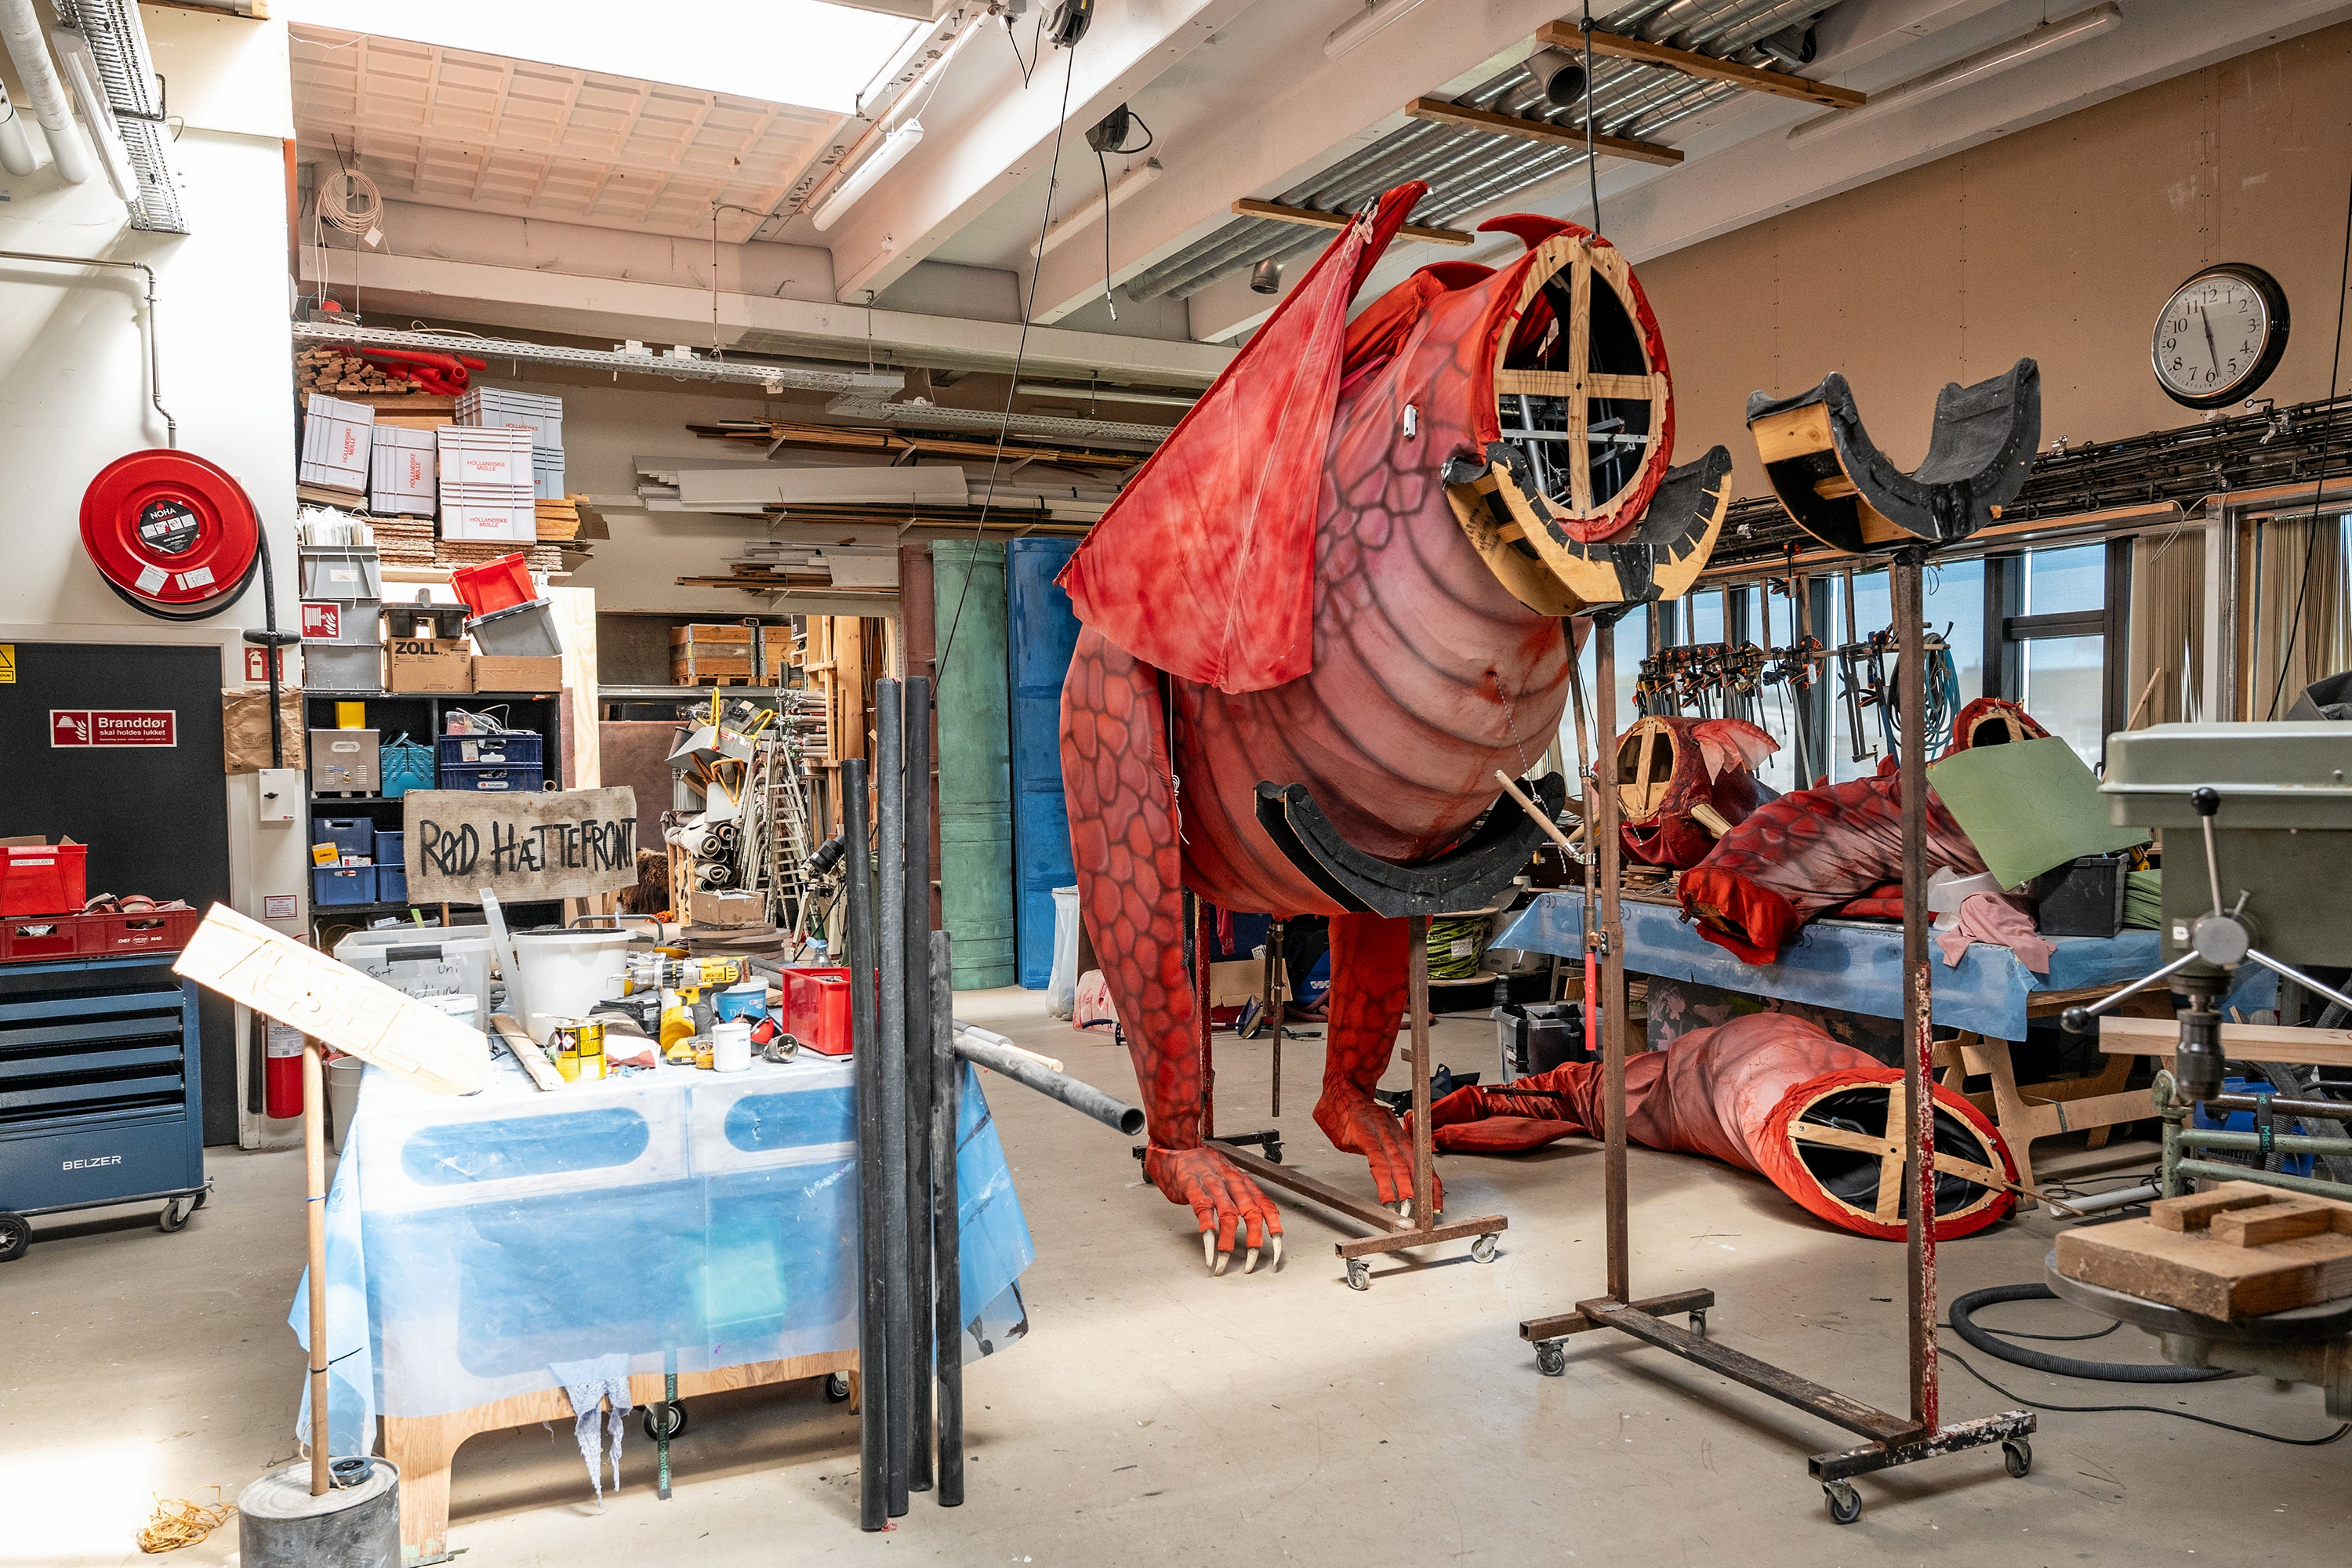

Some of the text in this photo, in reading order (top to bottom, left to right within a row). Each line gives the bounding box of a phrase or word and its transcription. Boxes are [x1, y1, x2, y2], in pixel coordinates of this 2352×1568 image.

[2201, 289, 2218, 304] 12
[2226, 290, 2233, 304] 1
[2186, 299, 2198, 315] 11
[2238, 299, 2248, 314] 2
[2172, 318, 2188, 334] 10
[2247, 318, 2256, 333] 3
[2166, 337, 2176, 354] 9
[2240, 339, 2250, 354] 4
[2172, 357, 2183, 371] 8
[2227, 358, 2237, 373] 5
[2189, 366, 2198, 381] 7
[2205, 368, 2216, 383] 6
[342, 427, 352, 463] HOLLANDSKE
[150, 507, 176, 519] NOHA
[395, 641, 439, 655] ZOLL
[98, 717, 167, 728] Branddør
[420, 818, 637, 877] RØD HÆTTEFRONT
[63, 1155, 122, 1171] BELZER
[659, 1422, 669, 1490] Mastodonterne
